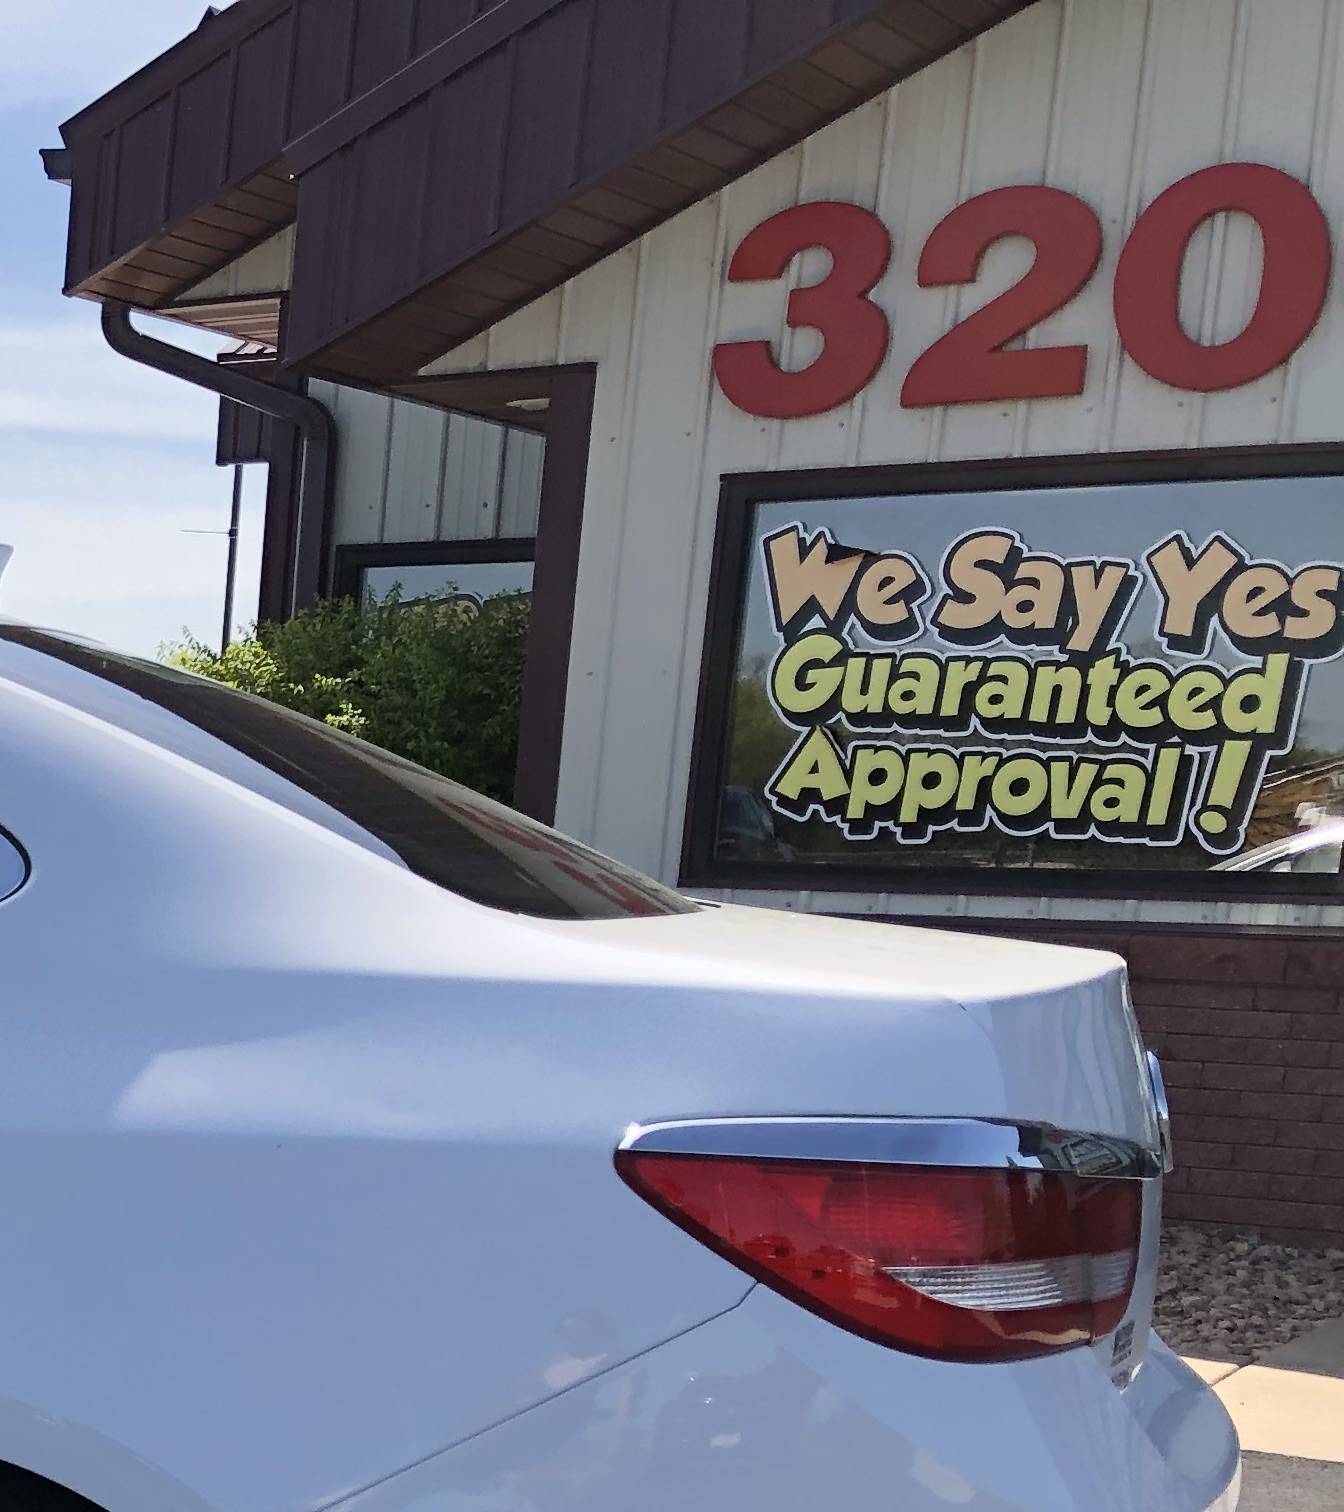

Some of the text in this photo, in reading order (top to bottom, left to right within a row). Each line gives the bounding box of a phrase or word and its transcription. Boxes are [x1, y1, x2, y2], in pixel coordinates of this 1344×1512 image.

[712, 162, 1331, 420] 320
[766, 525, 1343, 654] We Say Yes
[772, 632, 1292, 736] Guaranteed
